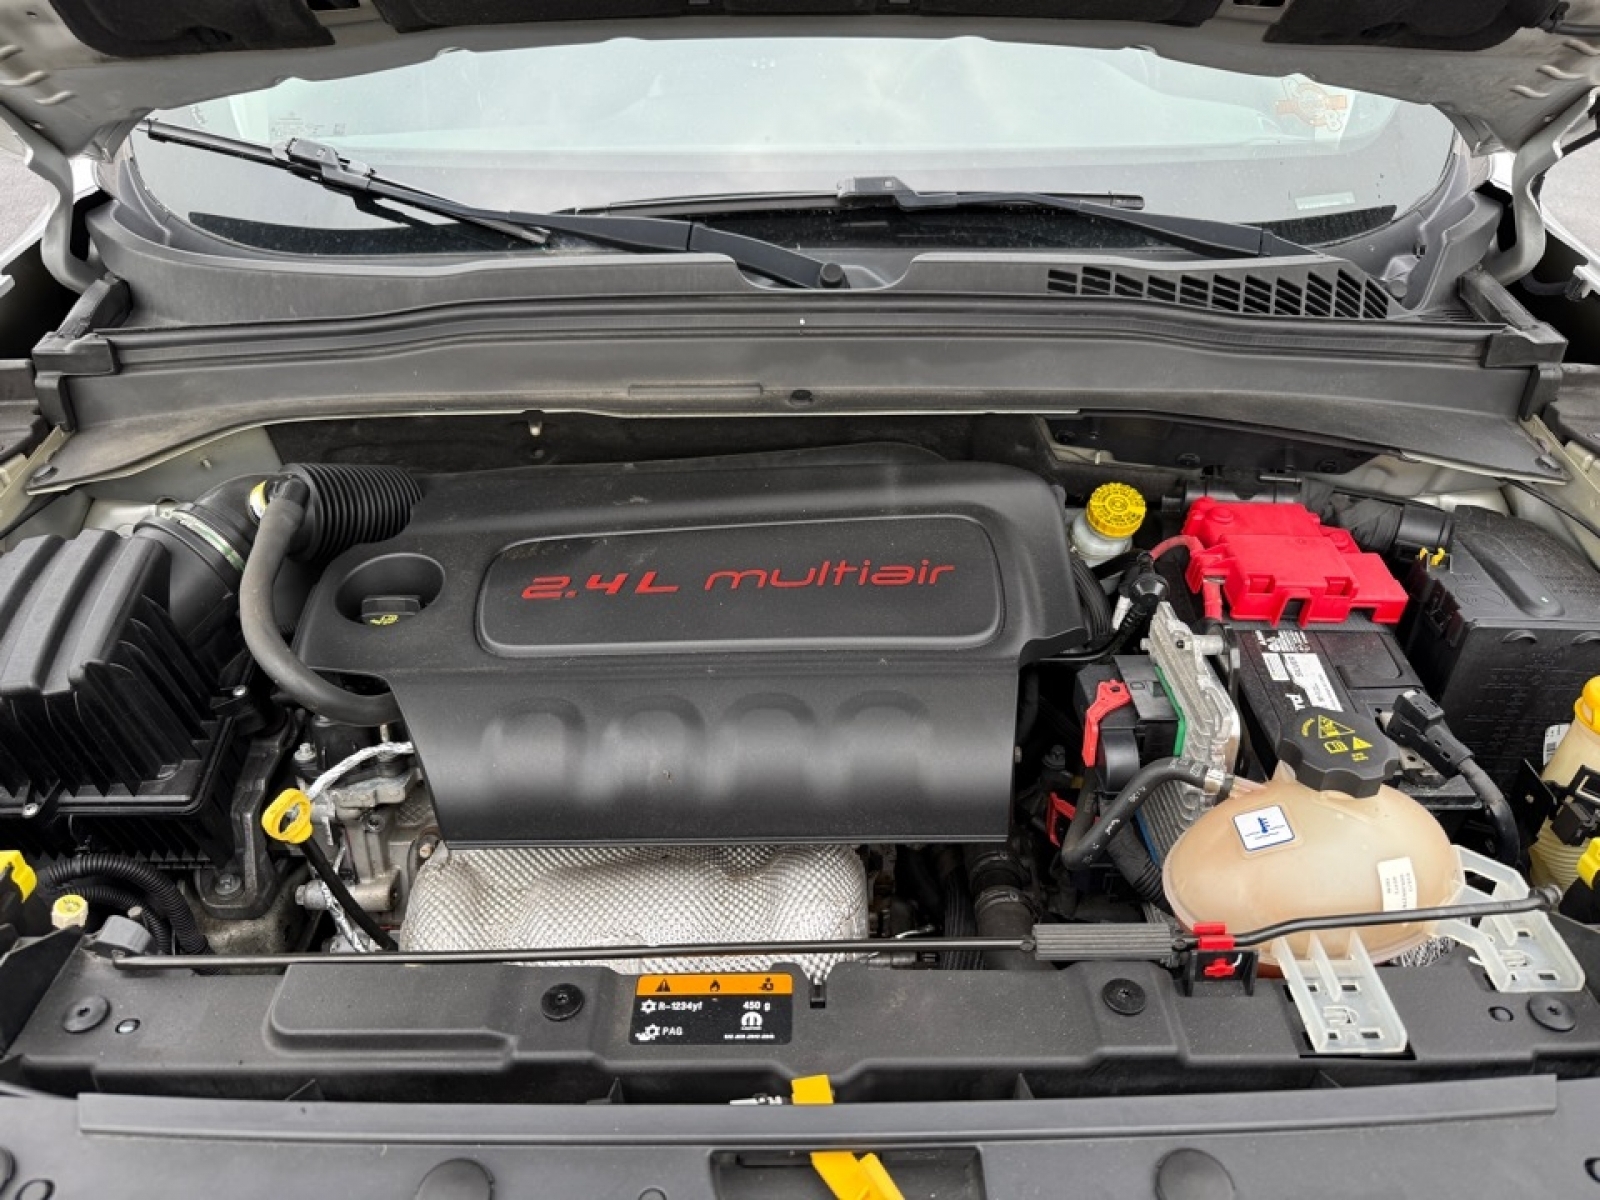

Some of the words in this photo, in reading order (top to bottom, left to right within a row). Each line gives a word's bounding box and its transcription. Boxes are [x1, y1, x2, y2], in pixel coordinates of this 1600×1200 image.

[705, 559, 955, 591] multiair
[743, 1001, 761, 1010] 450
[764, 1002, 771, 1012] g
[661, 1026, 683, 1036] PAG
